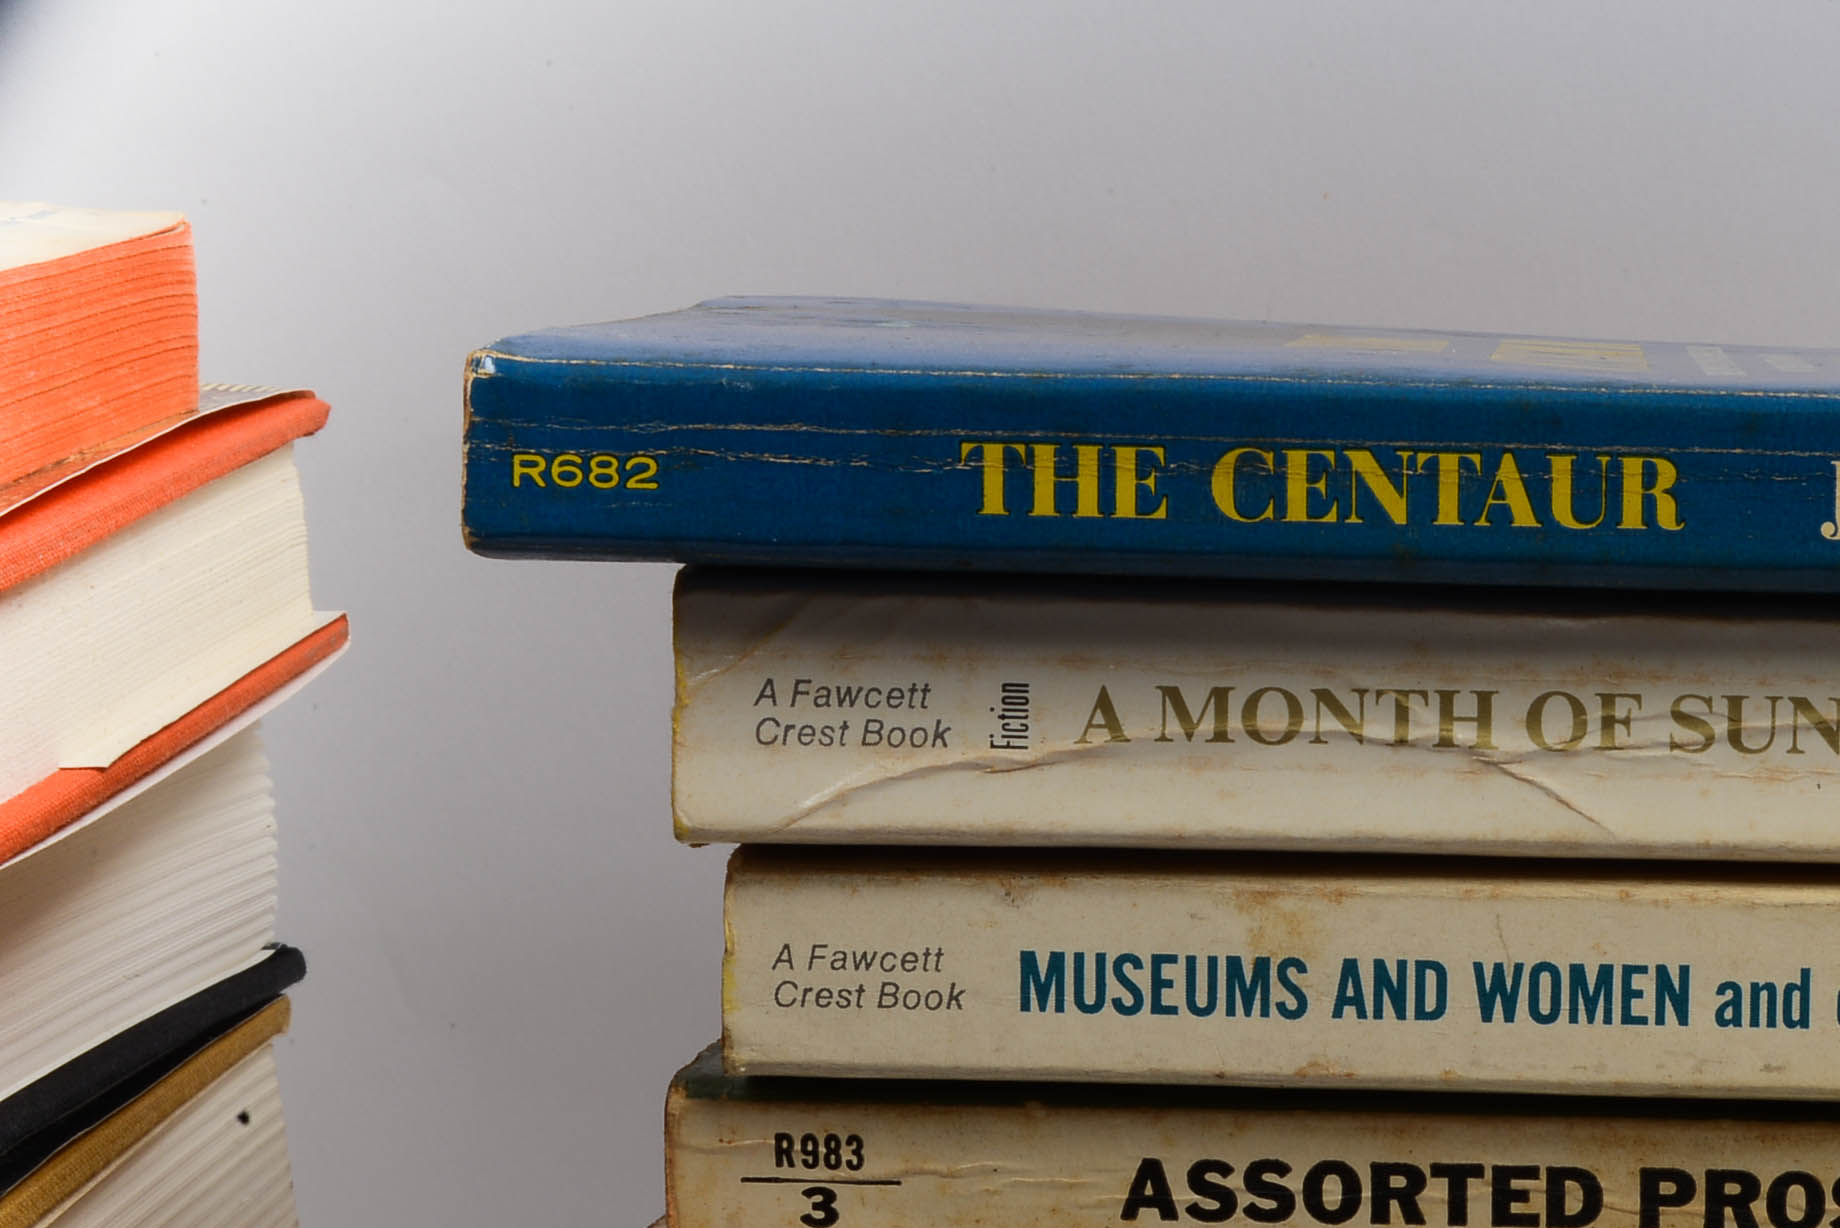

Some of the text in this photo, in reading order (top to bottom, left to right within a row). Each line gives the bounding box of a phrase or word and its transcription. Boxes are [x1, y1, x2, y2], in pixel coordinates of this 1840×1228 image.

[512, 452, 661, 490] R682
[957, 443, 1684, 530] THE CENTAUR
[754, 678, 931, 709] A Fawcett
[756, 717, 951, 748] Crest Book
[990, 683, 1029, 749] Fiction
[1075, 685, 1131, 745] A
[1155, 685, 1500, 751] MONTH
[1525, 690, 1639, 753] OF
[772, 944, 944, 972] A Fawcett
[775, 981, 965, 1010] Crest Book
[1020, 951, 1307, 1020] MUSEUMS
[1332, 958, 1447, 1020] AND
[1473, 961, 1689, 1026] WOMEN
[1715, 968, 1810, 1029] and
[774, 1132, 865, 1172] R983
[800, 1187, 839, 1228] 3
[1121, 1158, 1603, 1228] ASSORTED
